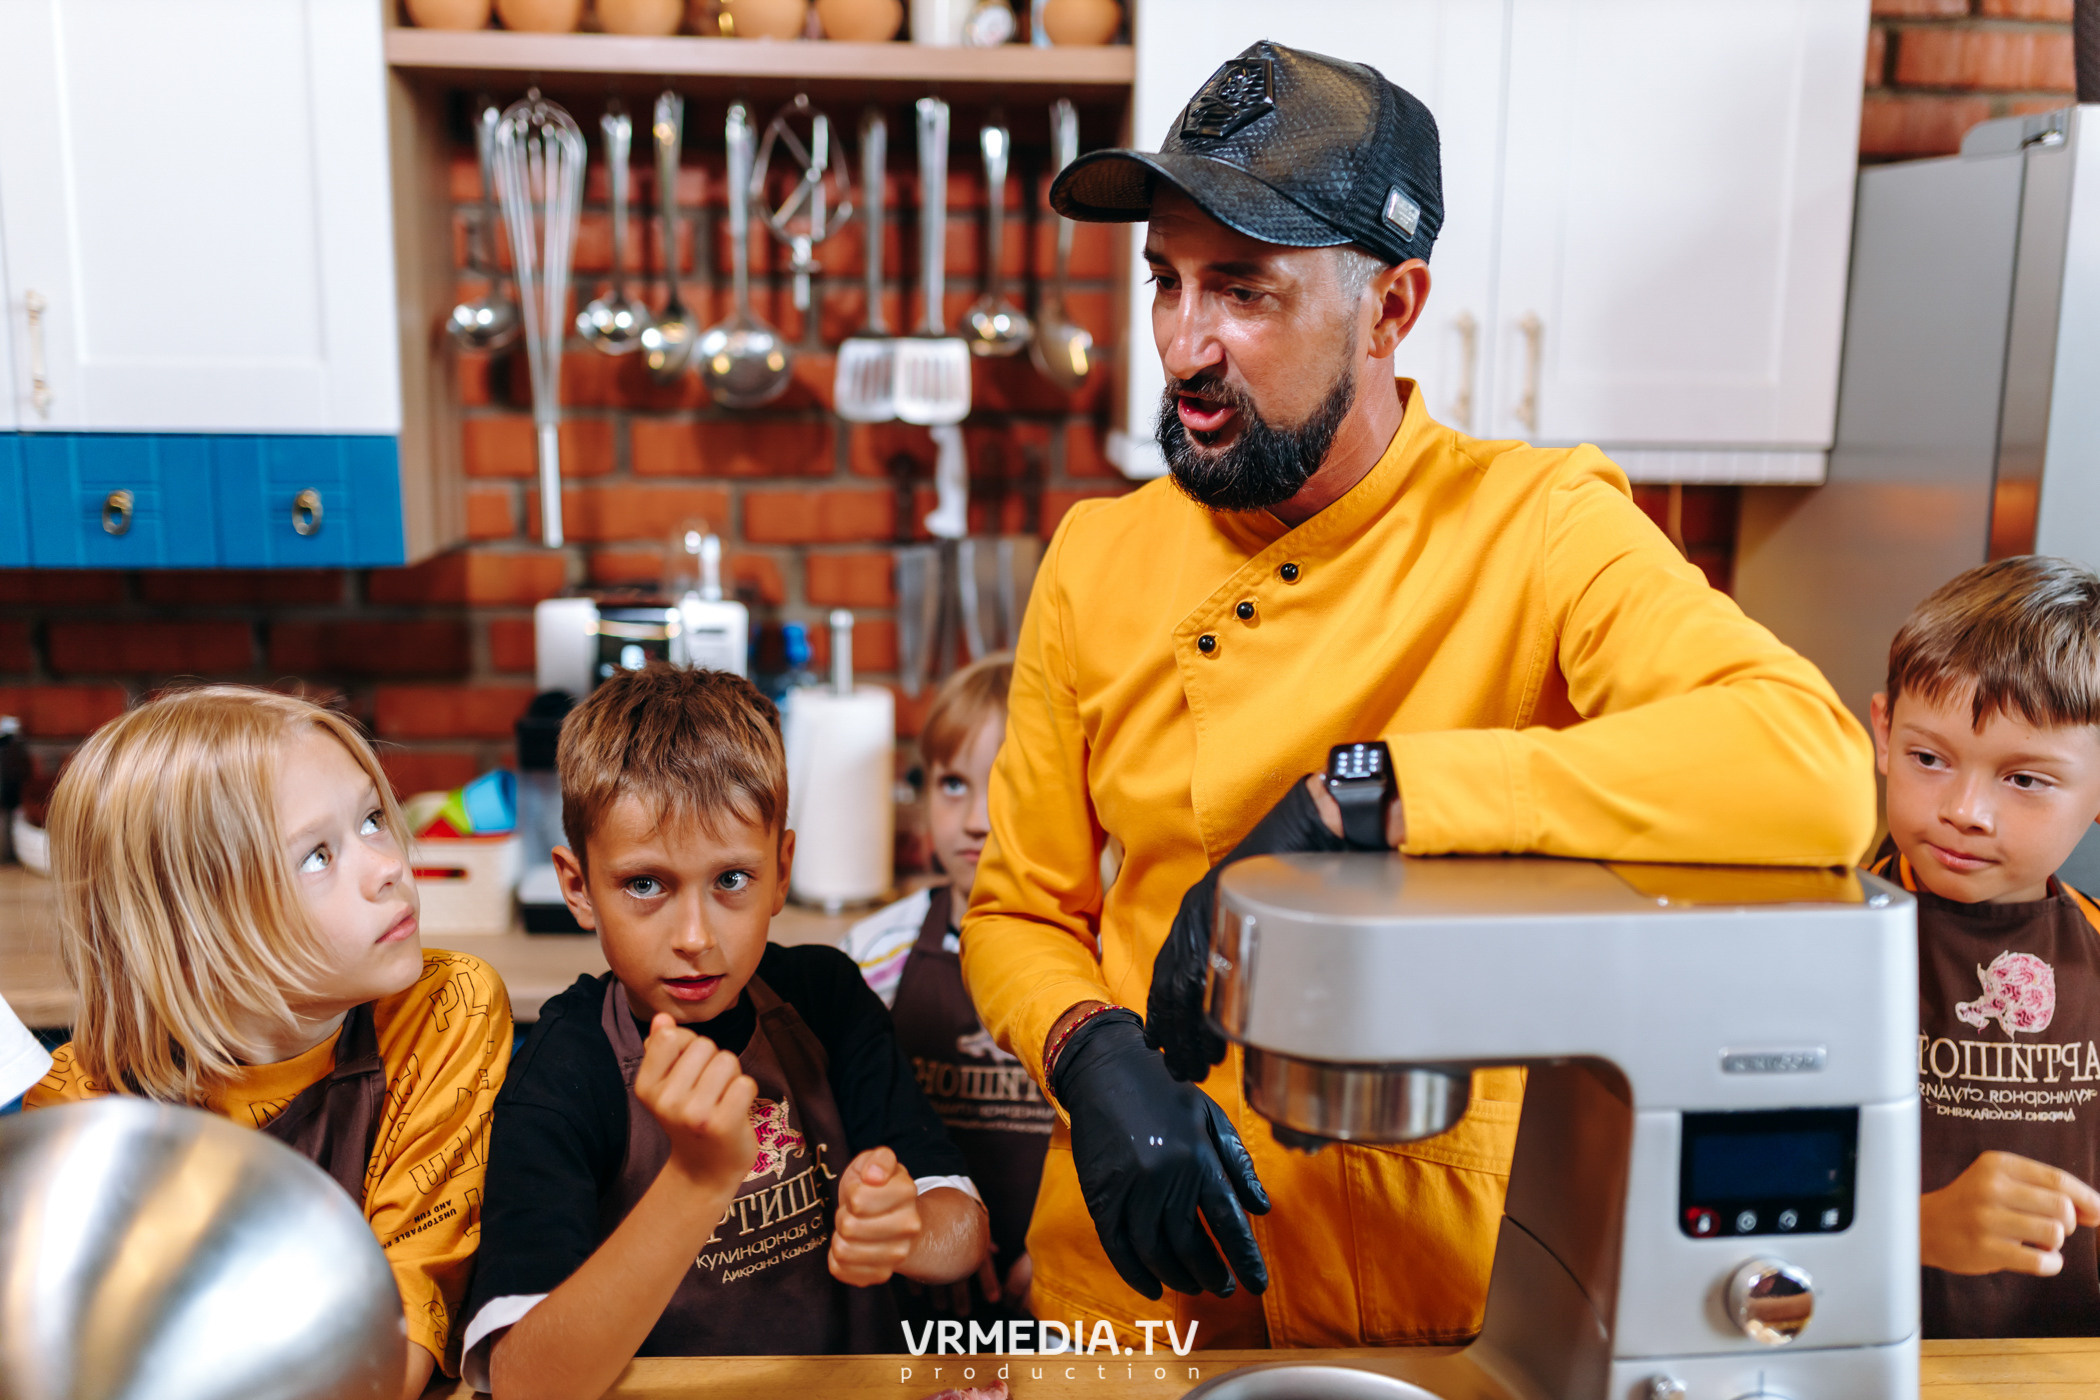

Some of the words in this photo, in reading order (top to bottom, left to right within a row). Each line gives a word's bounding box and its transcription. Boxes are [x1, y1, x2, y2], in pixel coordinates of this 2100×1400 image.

[433, 1199, 452, 1214] AND
[414, 1211, 432, 1224] FUN
[395, 1208, 457, 1244] UNSTOPPABLE
